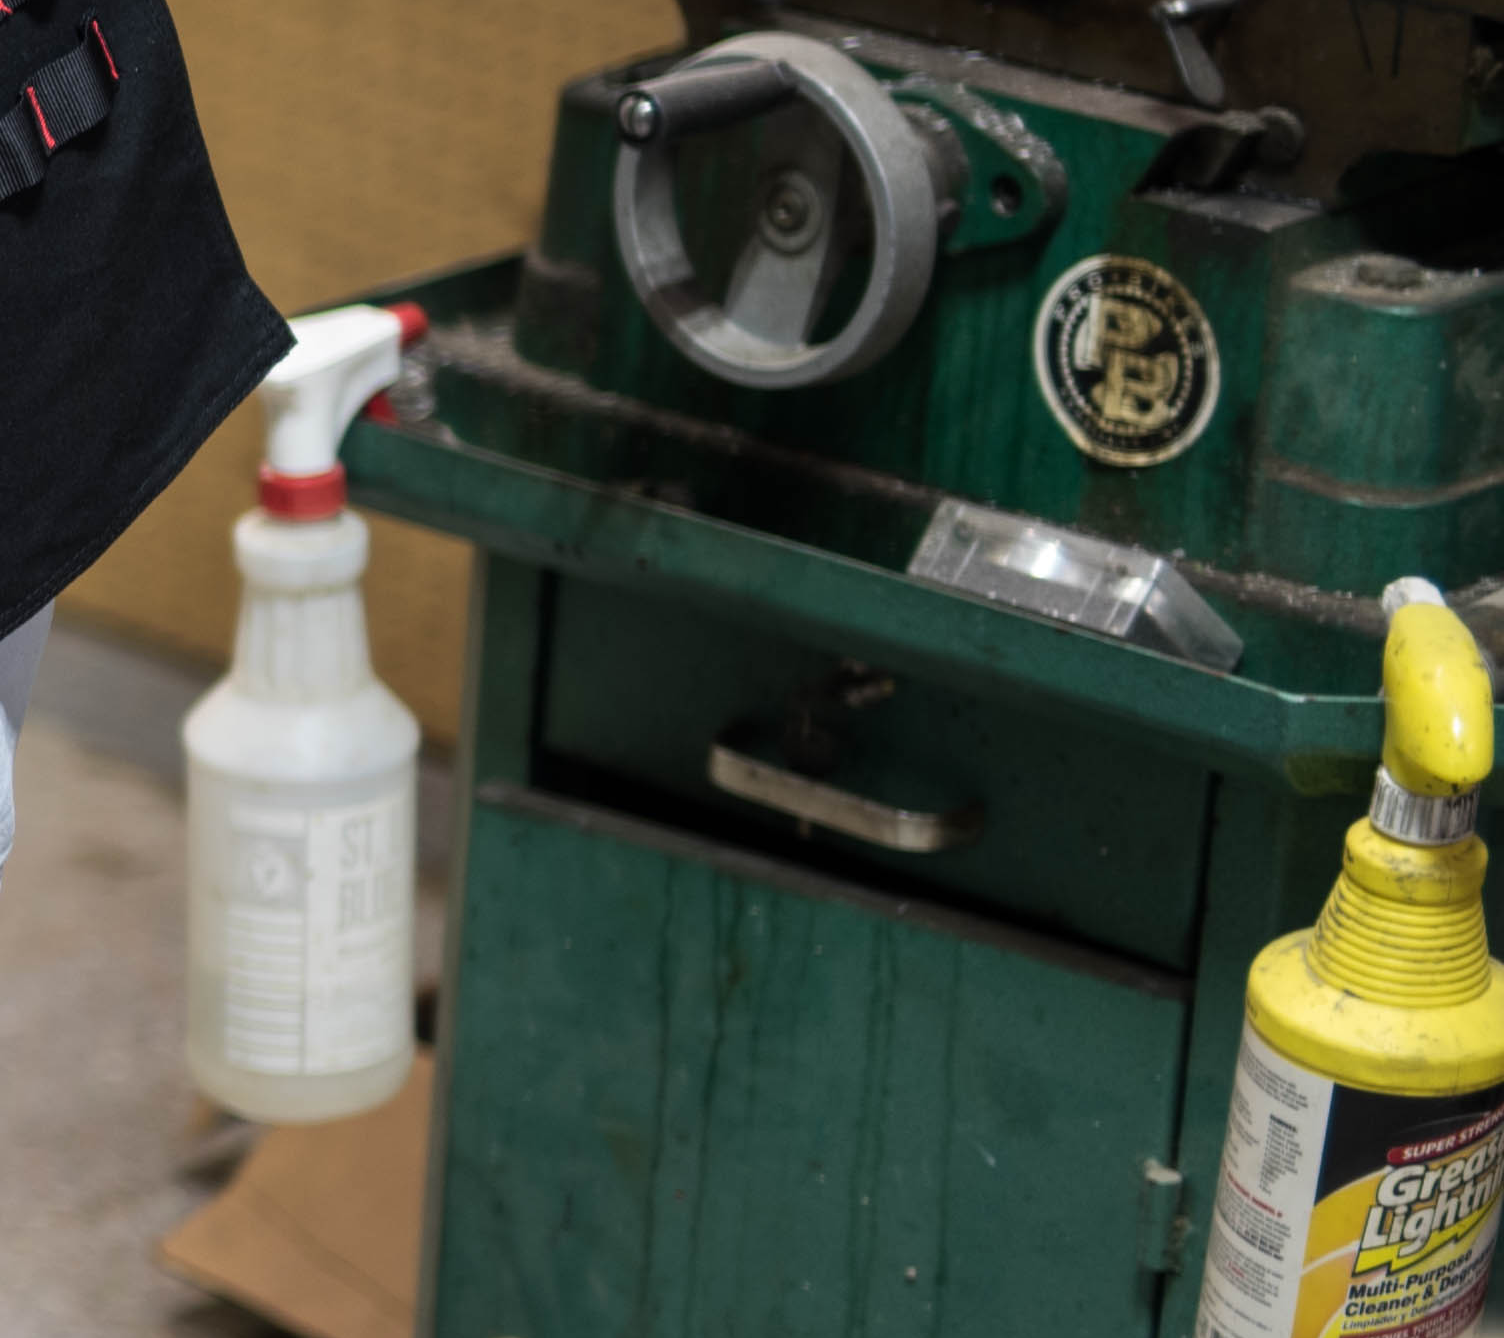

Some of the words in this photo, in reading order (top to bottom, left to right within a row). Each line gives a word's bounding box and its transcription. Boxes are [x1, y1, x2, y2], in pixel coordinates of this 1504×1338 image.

[1402, 1135, 1456, 1160] SUPER
[1349, 1249, 1473, 1300] Multi-Purpose
[1345, 1292, 1419, 1317] Cleaner
